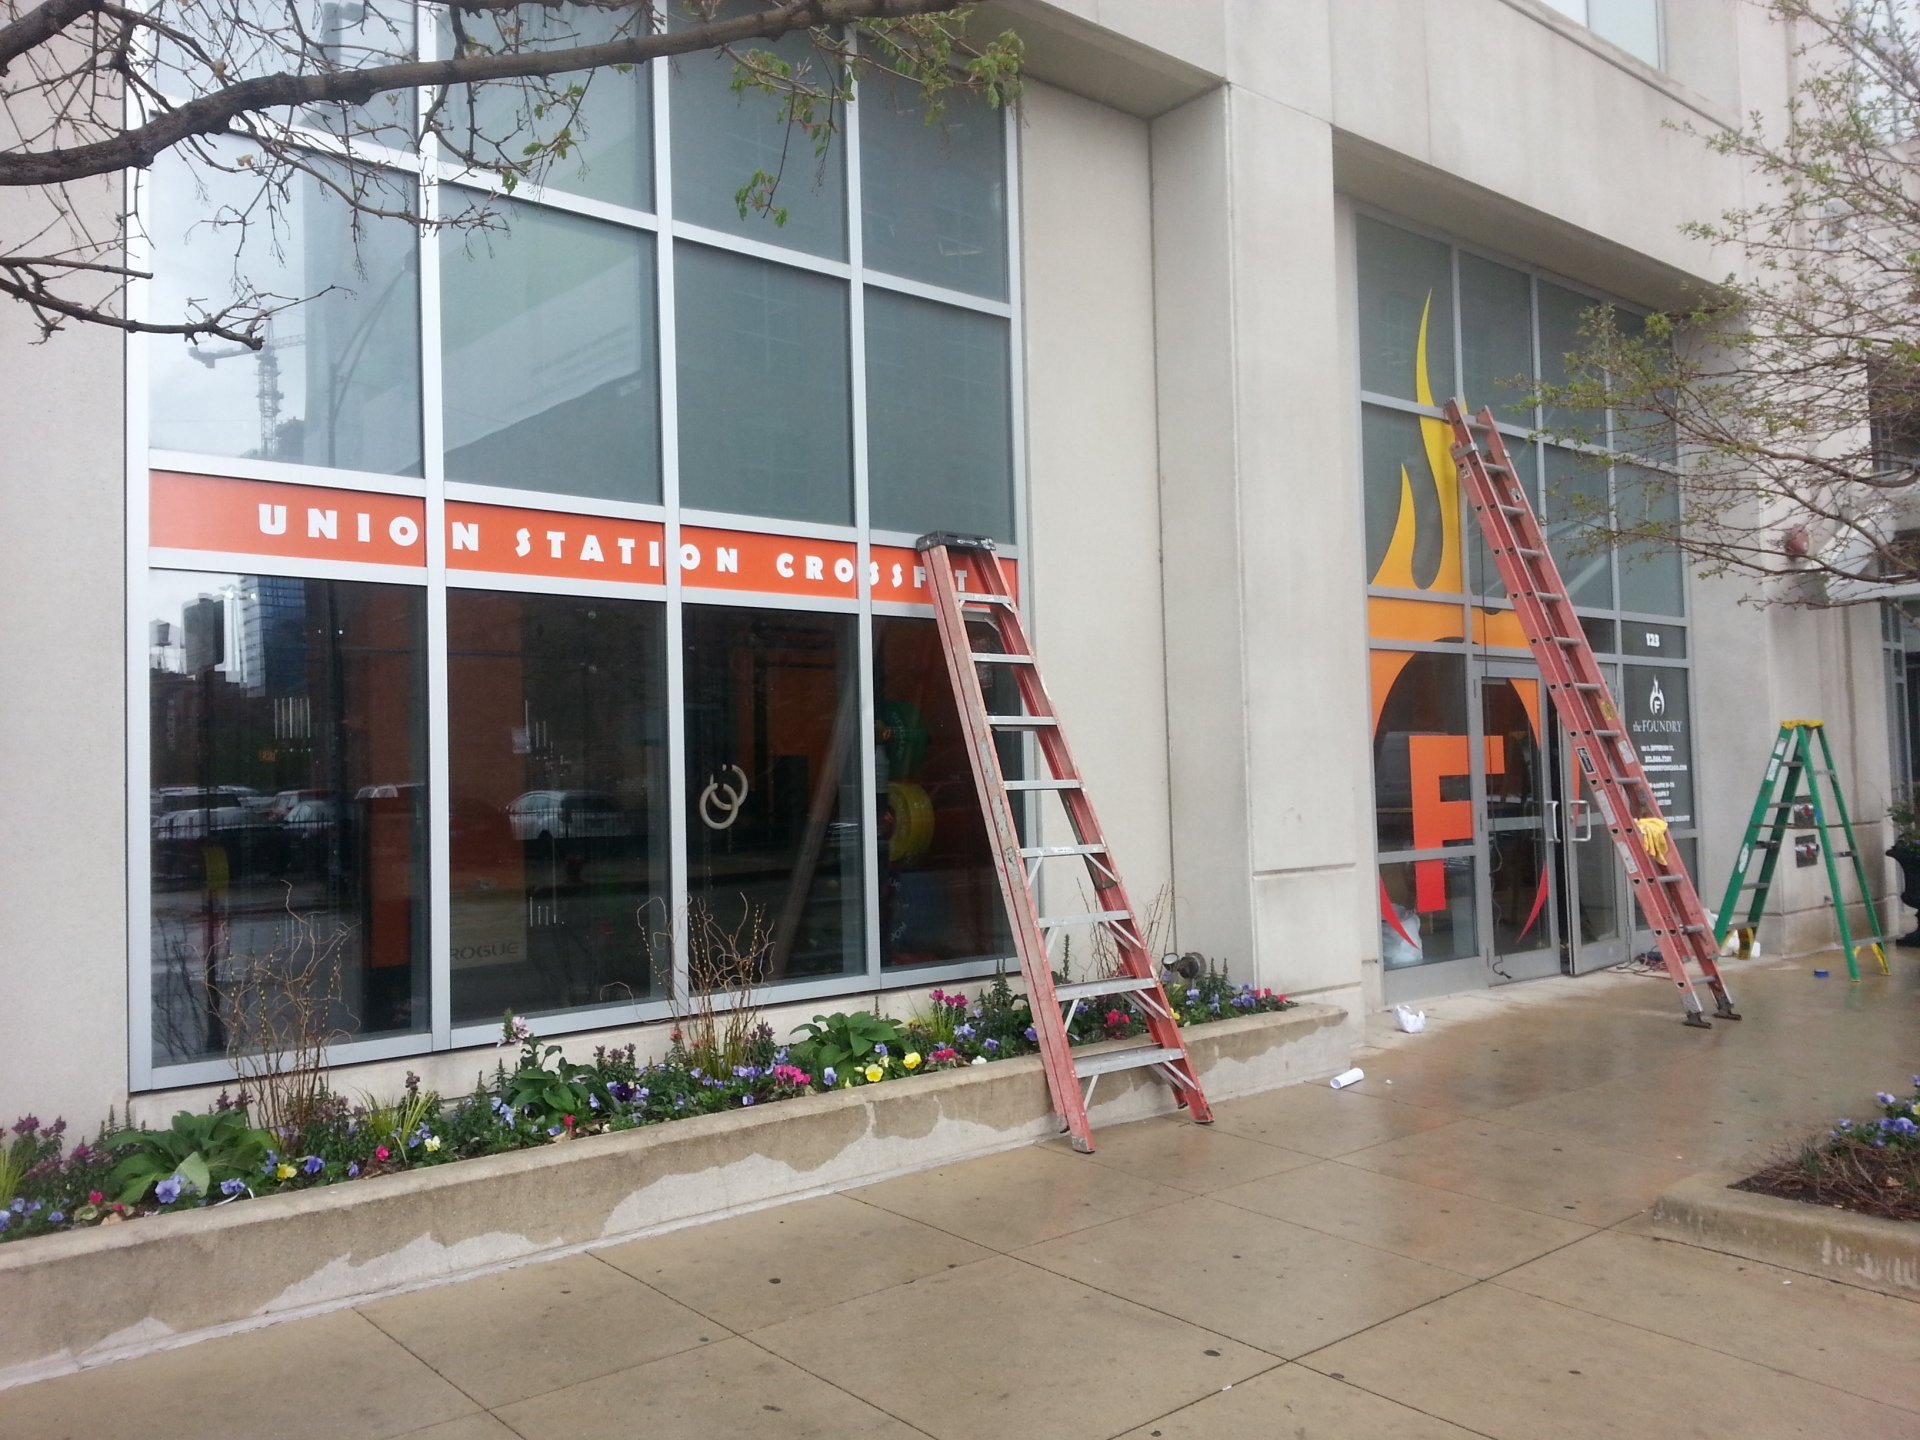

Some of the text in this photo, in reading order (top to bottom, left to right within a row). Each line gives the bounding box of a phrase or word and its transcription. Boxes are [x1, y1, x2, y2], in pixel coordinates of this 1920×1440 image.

[258, 503, 968, 592] UNION STATION CROSSFT
[1646, 632, 1660, 648] 123
[450, 942, 520, 960] ROGUE
